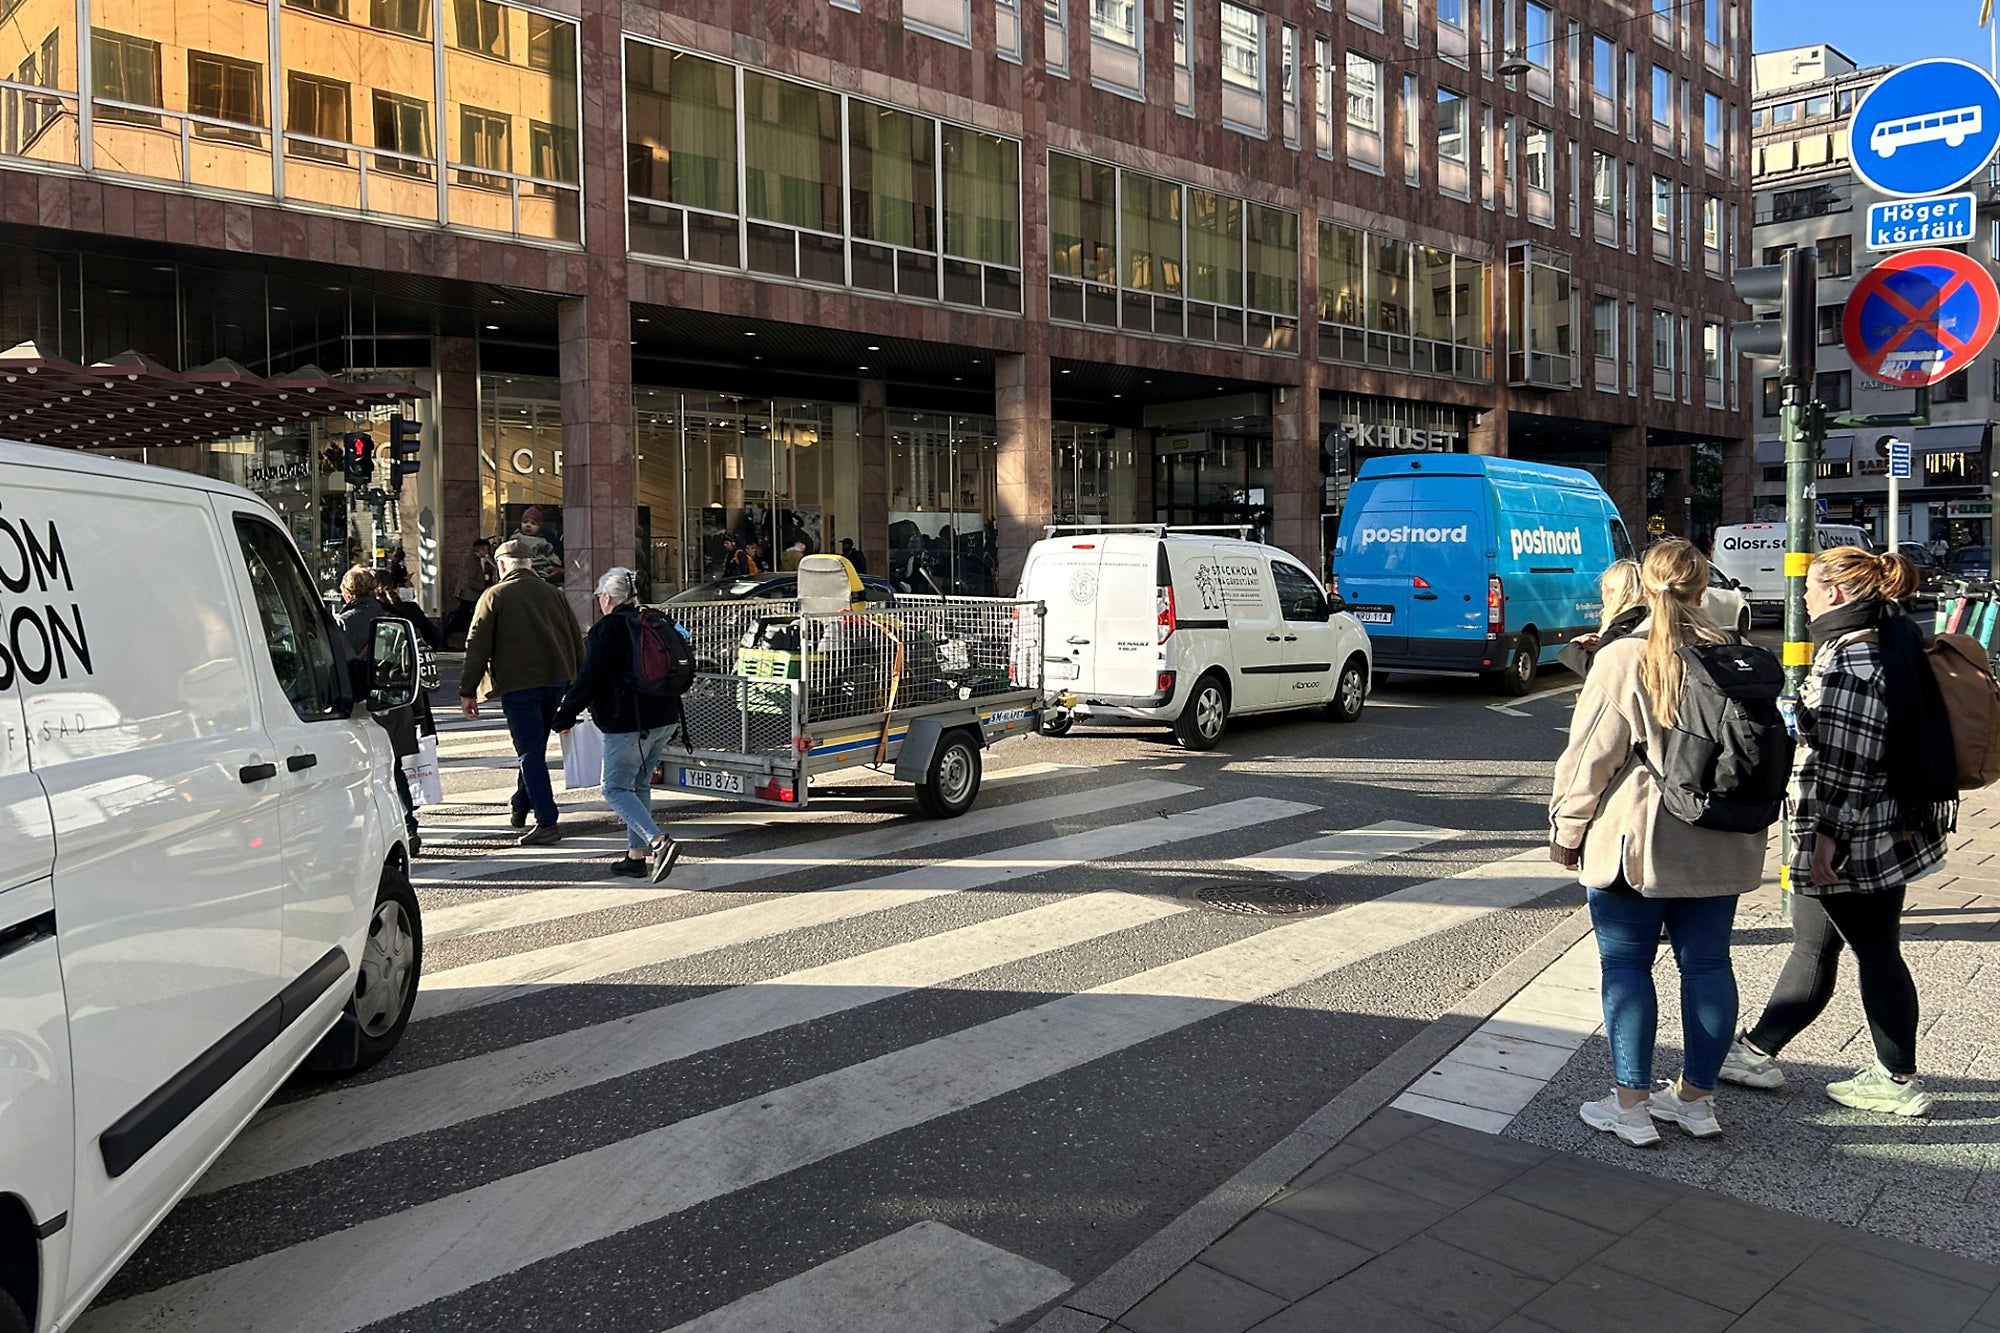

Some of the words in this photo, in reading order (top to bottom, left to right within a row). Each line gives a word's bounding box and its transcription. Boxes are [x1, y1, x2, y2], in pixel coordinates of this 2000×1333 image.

[1883, 202, 1960, 223] Höger
[1878, 220, 1964, 245] körfält
[1340, 423, 1459, 453] PKHUSET
[1362, 525, 1467, 546] postnord
[1510, 526, 1582, 560] postnord
[7, 713, 86, 751] FASAD
[690, 771, 712, 787] YHB
[715, 774, 739, 790] 873
